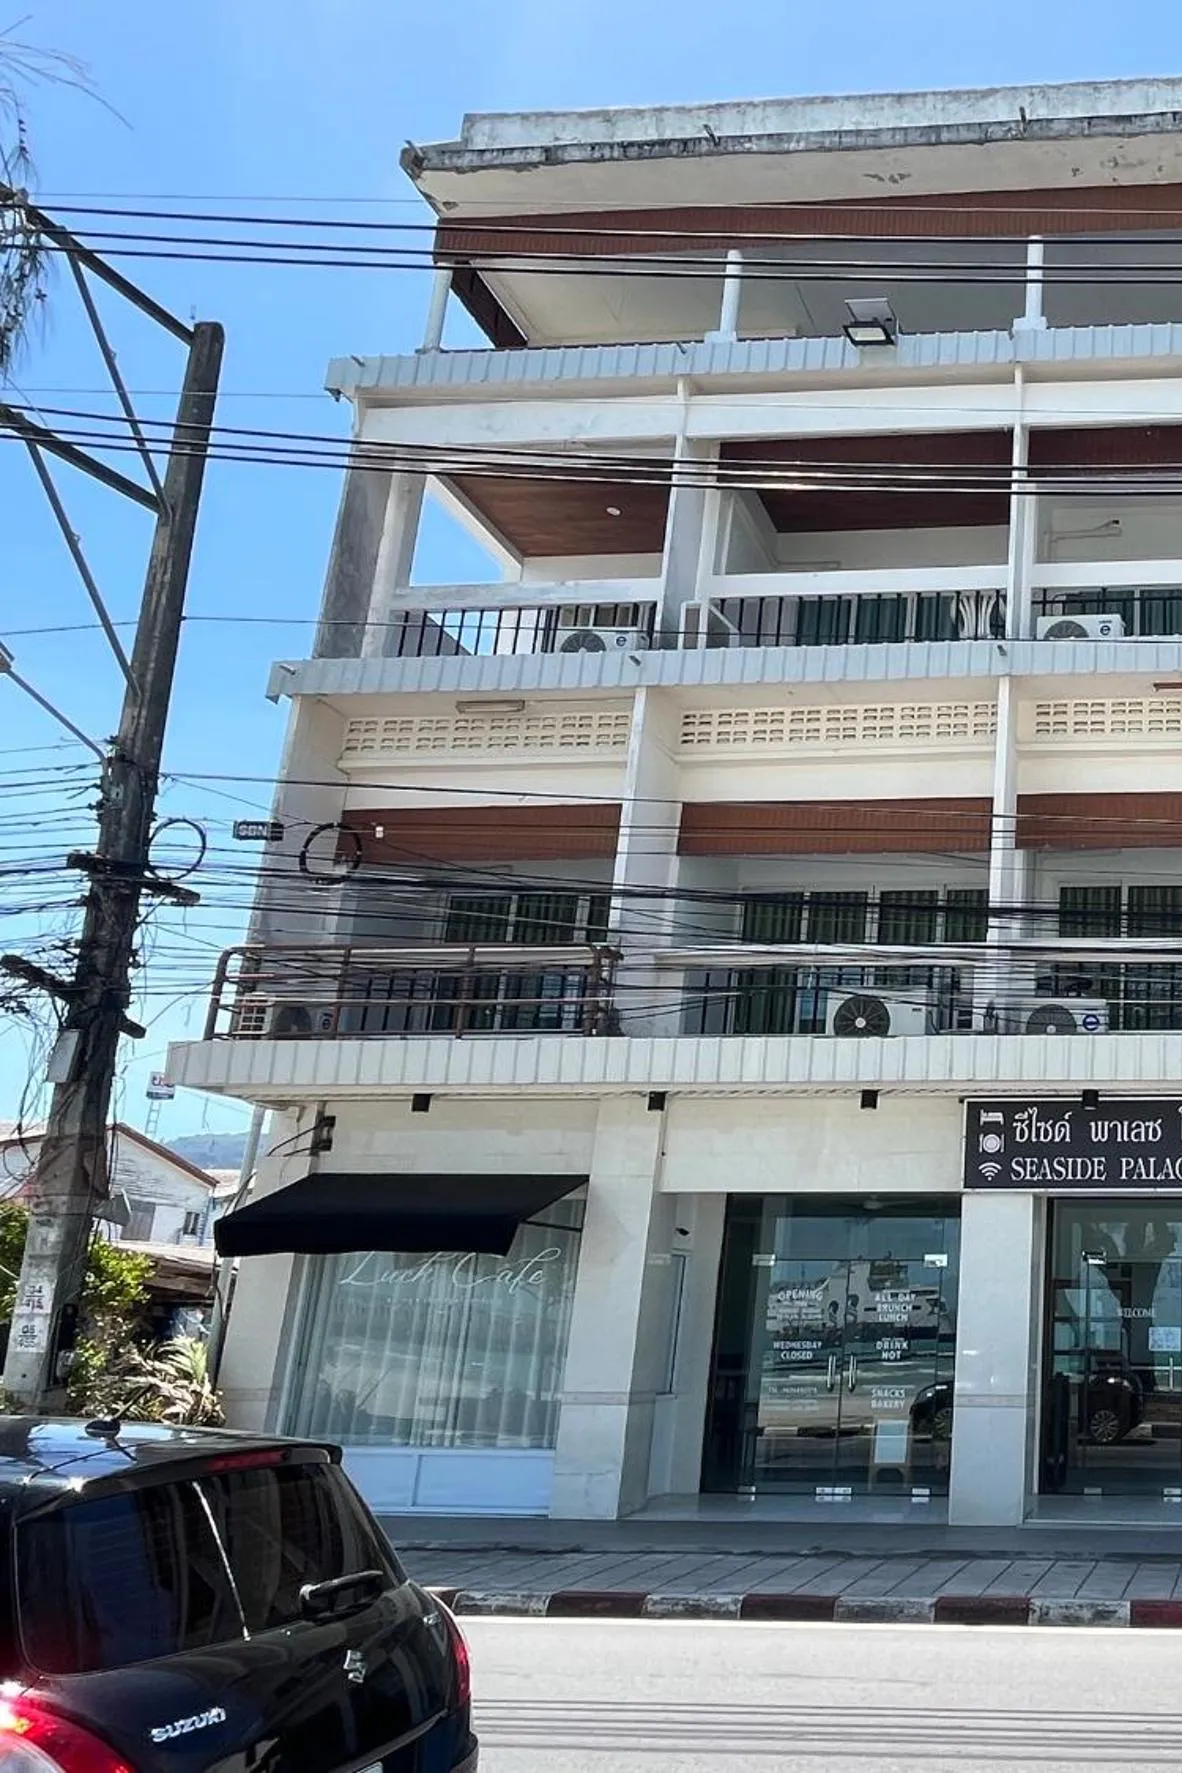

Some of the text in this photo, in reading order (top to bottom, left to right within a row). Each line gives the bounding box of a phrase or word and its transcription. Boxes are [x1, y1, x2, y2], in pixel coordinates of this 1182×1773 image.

[1089, 1118, 1162, 1142] พาเลซ
[1011, 1156, 1107, 1181] SEASIDE
[773, 1340, 822, 1350] WEDNESDAY
[875, 1341, 909, 1350] DRINK
[781, 1350, 813, 1360] CLOSED
[871, 1388, 905, 1399] SNACKS
[870, 1399, 905, 1409] BAKERY
[150, 1707, 226, 1742] SUZUKI
